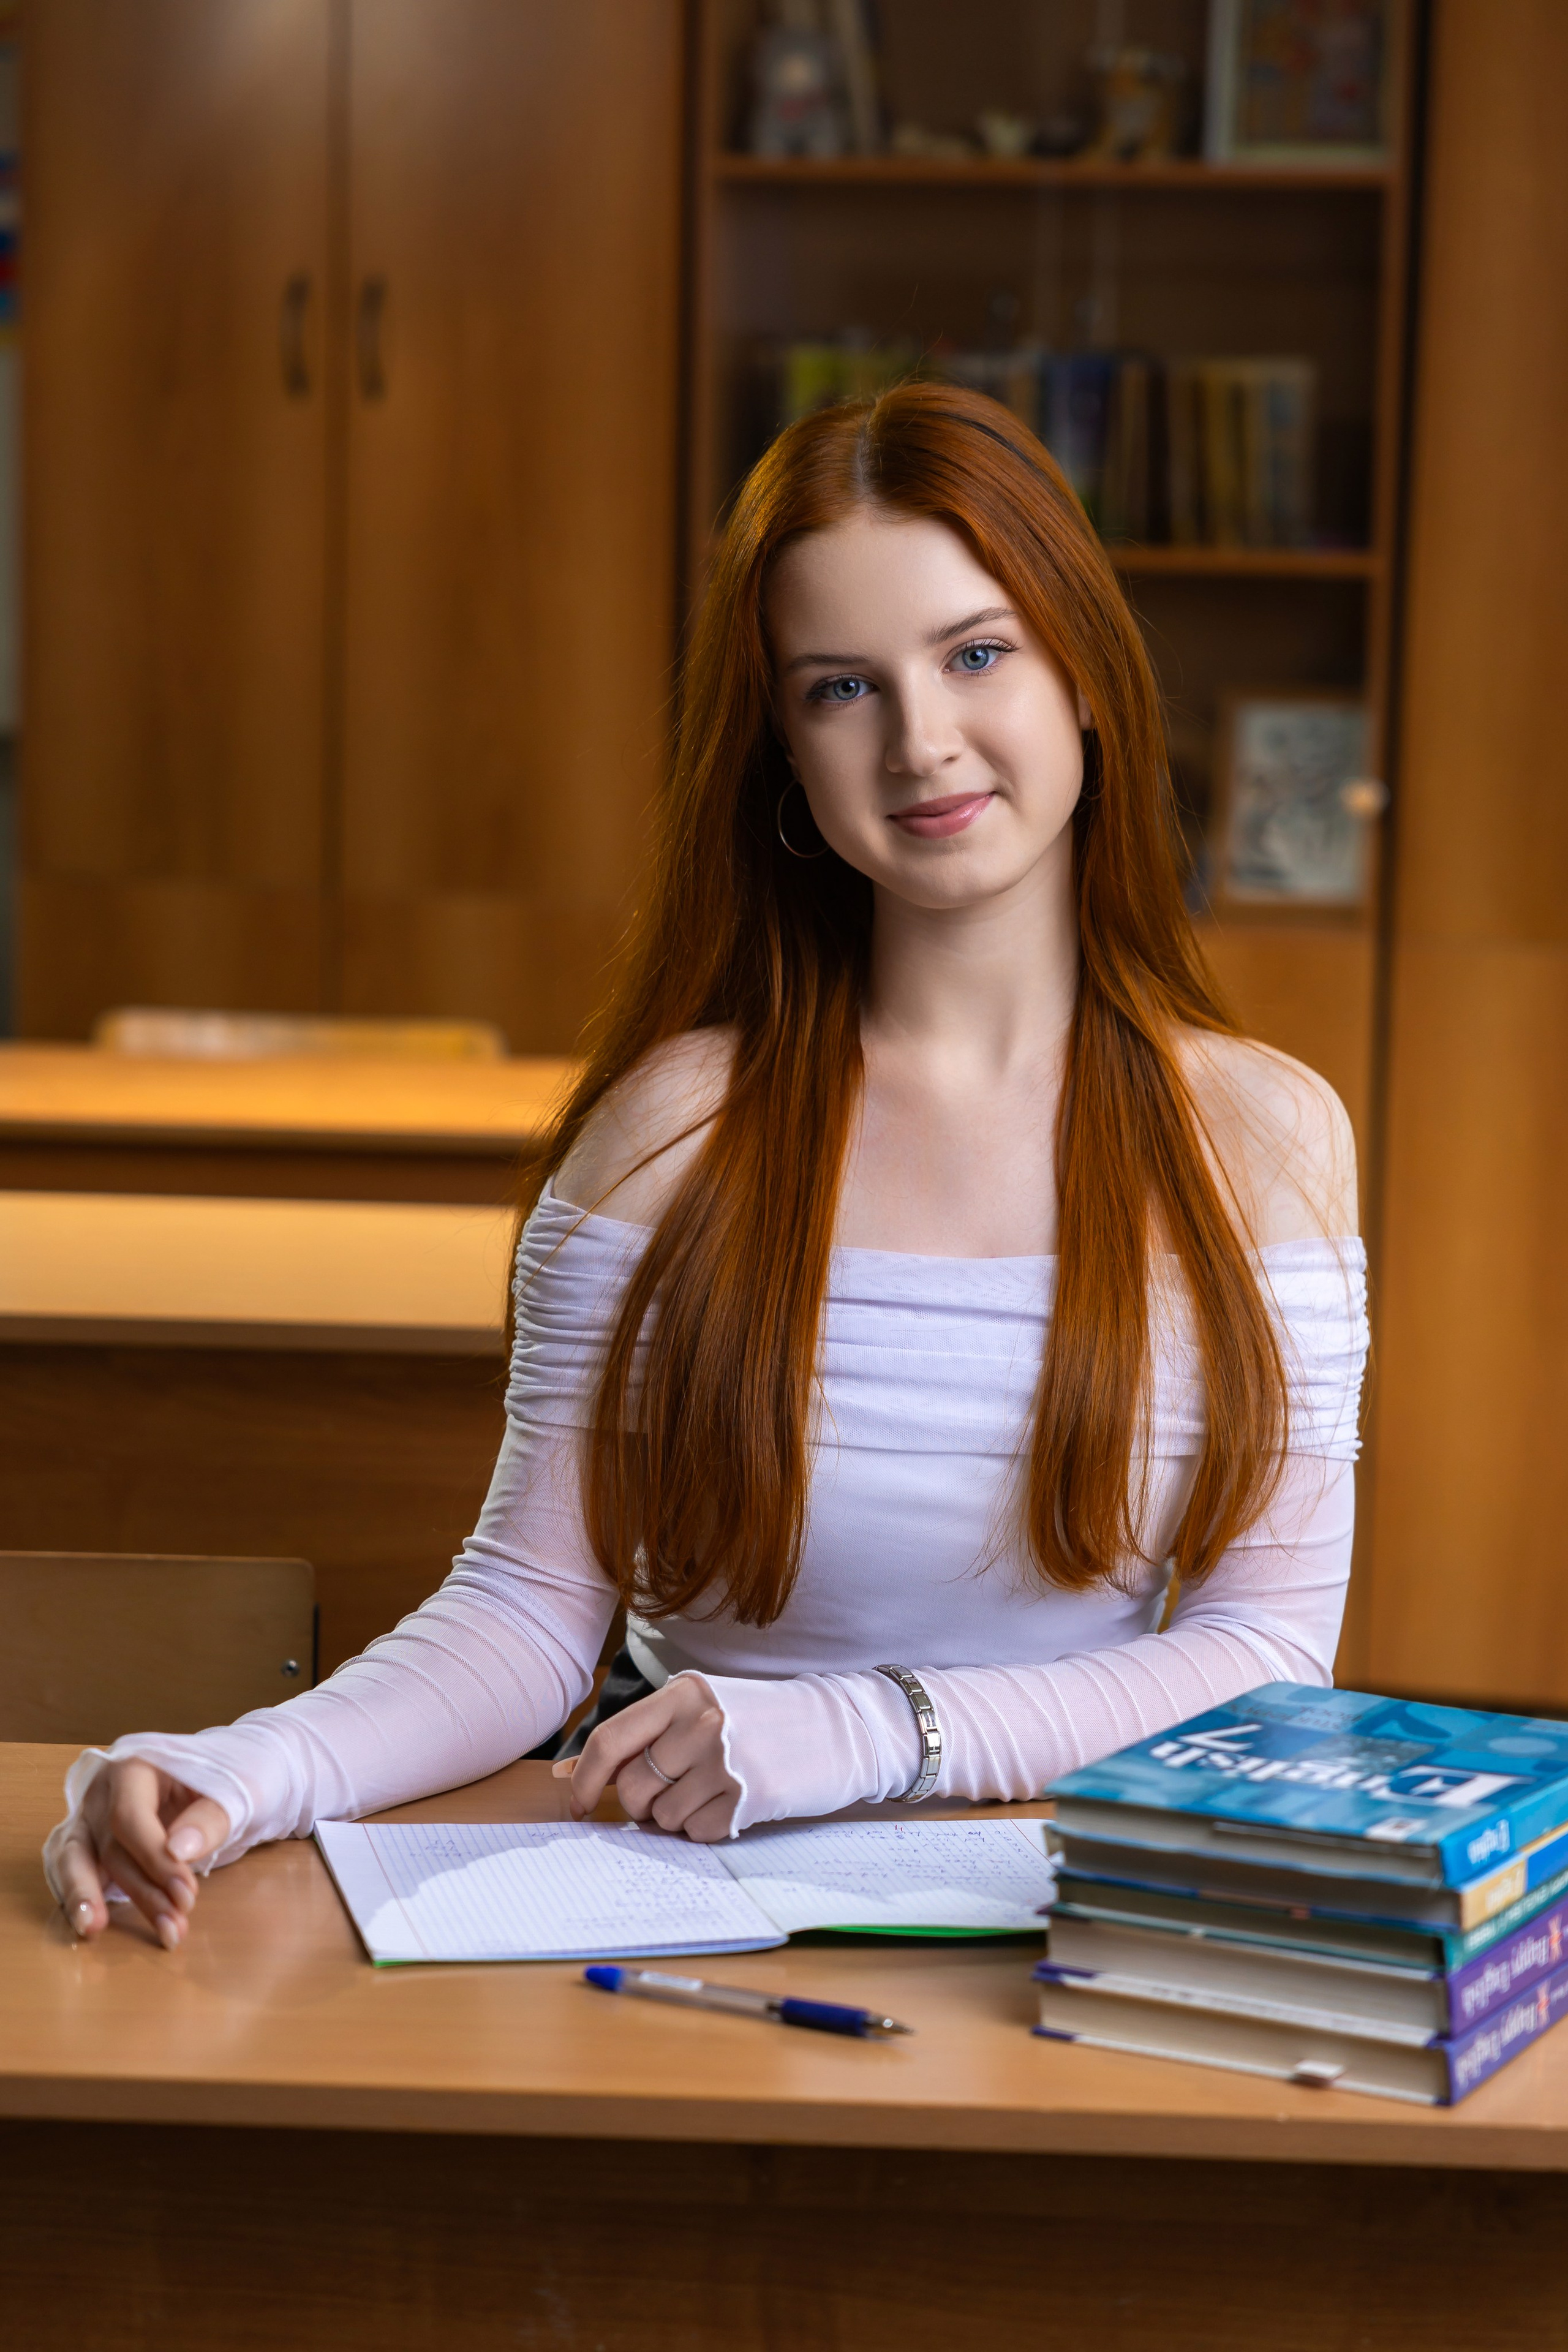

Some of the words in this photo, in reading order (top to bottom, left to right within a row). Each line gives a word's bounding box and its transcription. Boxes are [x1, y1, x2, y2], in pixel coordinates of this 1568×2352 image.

[1177, 1723, 1264, 1752] 7
[1149, 1740, 1536, 1808] English
[1511, 1936, 1549, 1979] Happy
[1461, 1961, 1511, 2018] English
[1501, 2003, 1537, 2047] Happy
[1454, 2030, 1501, 2089] English
